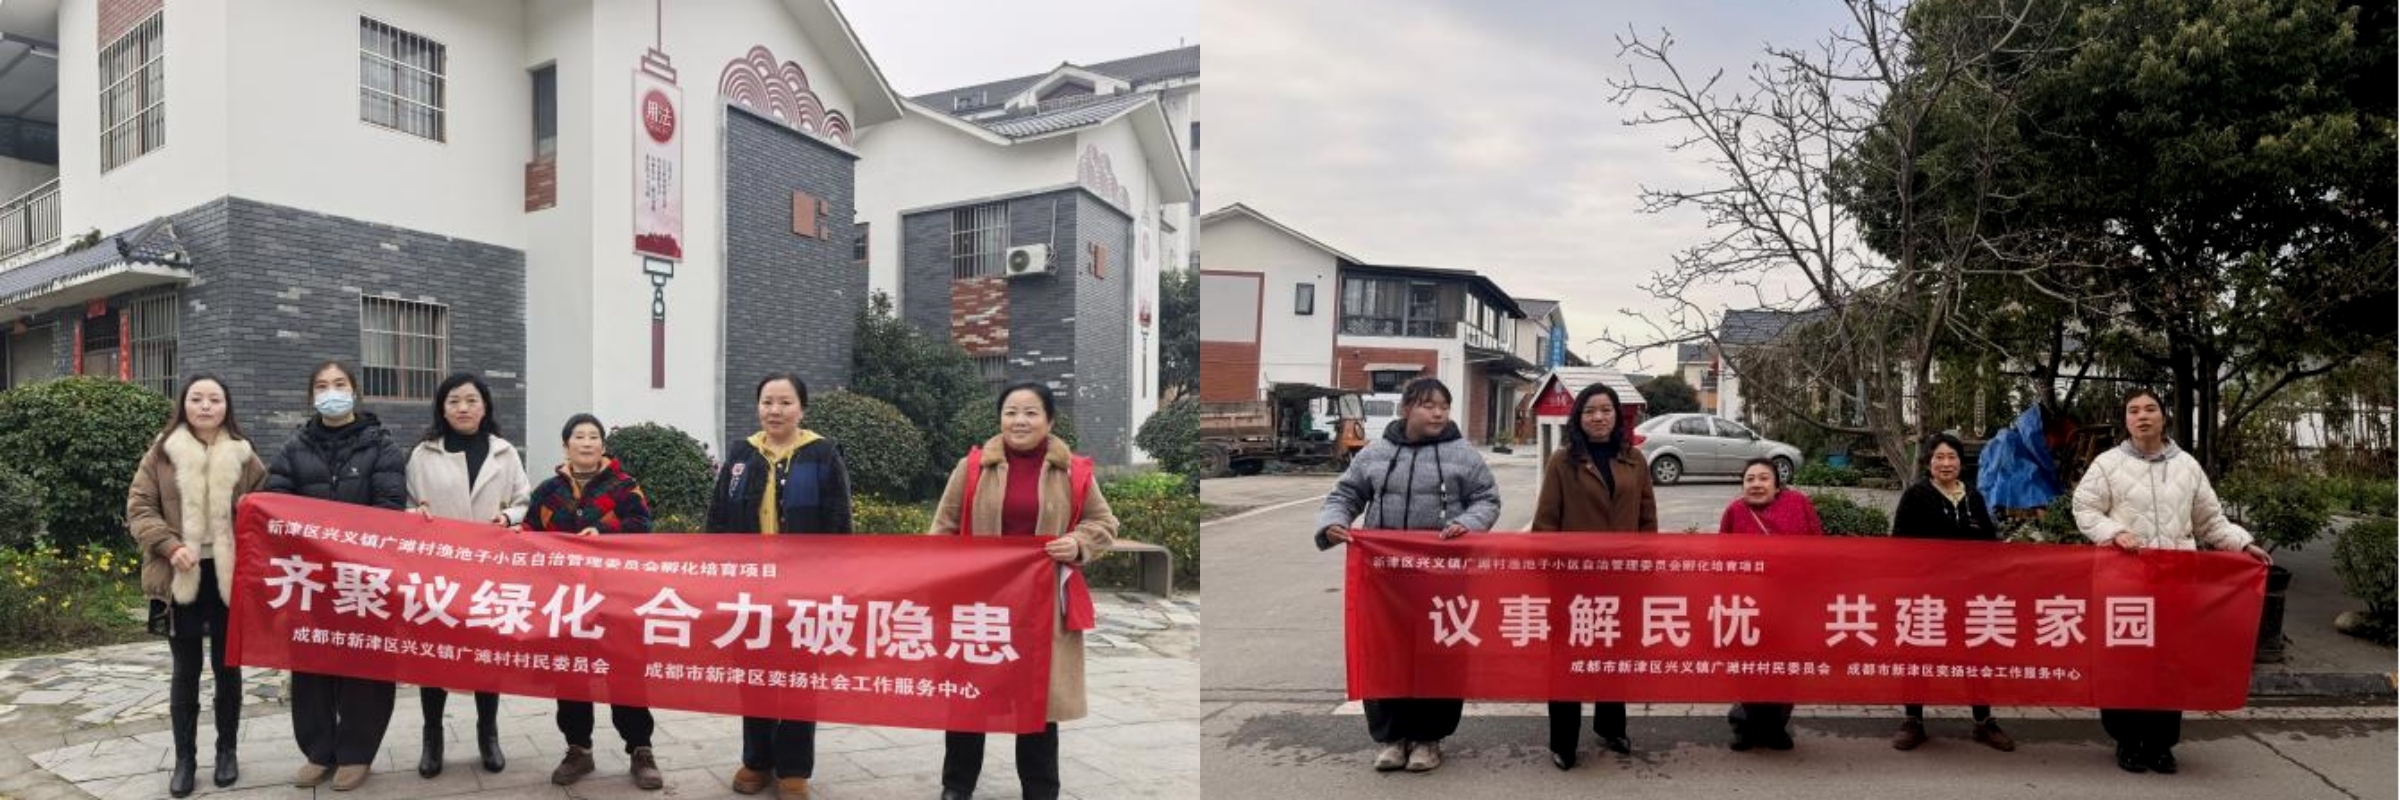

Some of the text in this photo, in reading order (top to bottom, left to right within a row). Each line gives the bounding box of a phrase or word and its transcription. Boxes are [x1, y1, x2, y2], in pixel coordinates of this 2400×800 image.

[264, 554, 1021, 665] 齐聚议绿化 合力破隐患
[1428, 594, 2156, 648] 议事解民忧 共建美家园
[292, 626, 981, 699] 成都市新津区兴义镇广滩村村民委员会 成都市新津区奕扬社会工作服务中心
